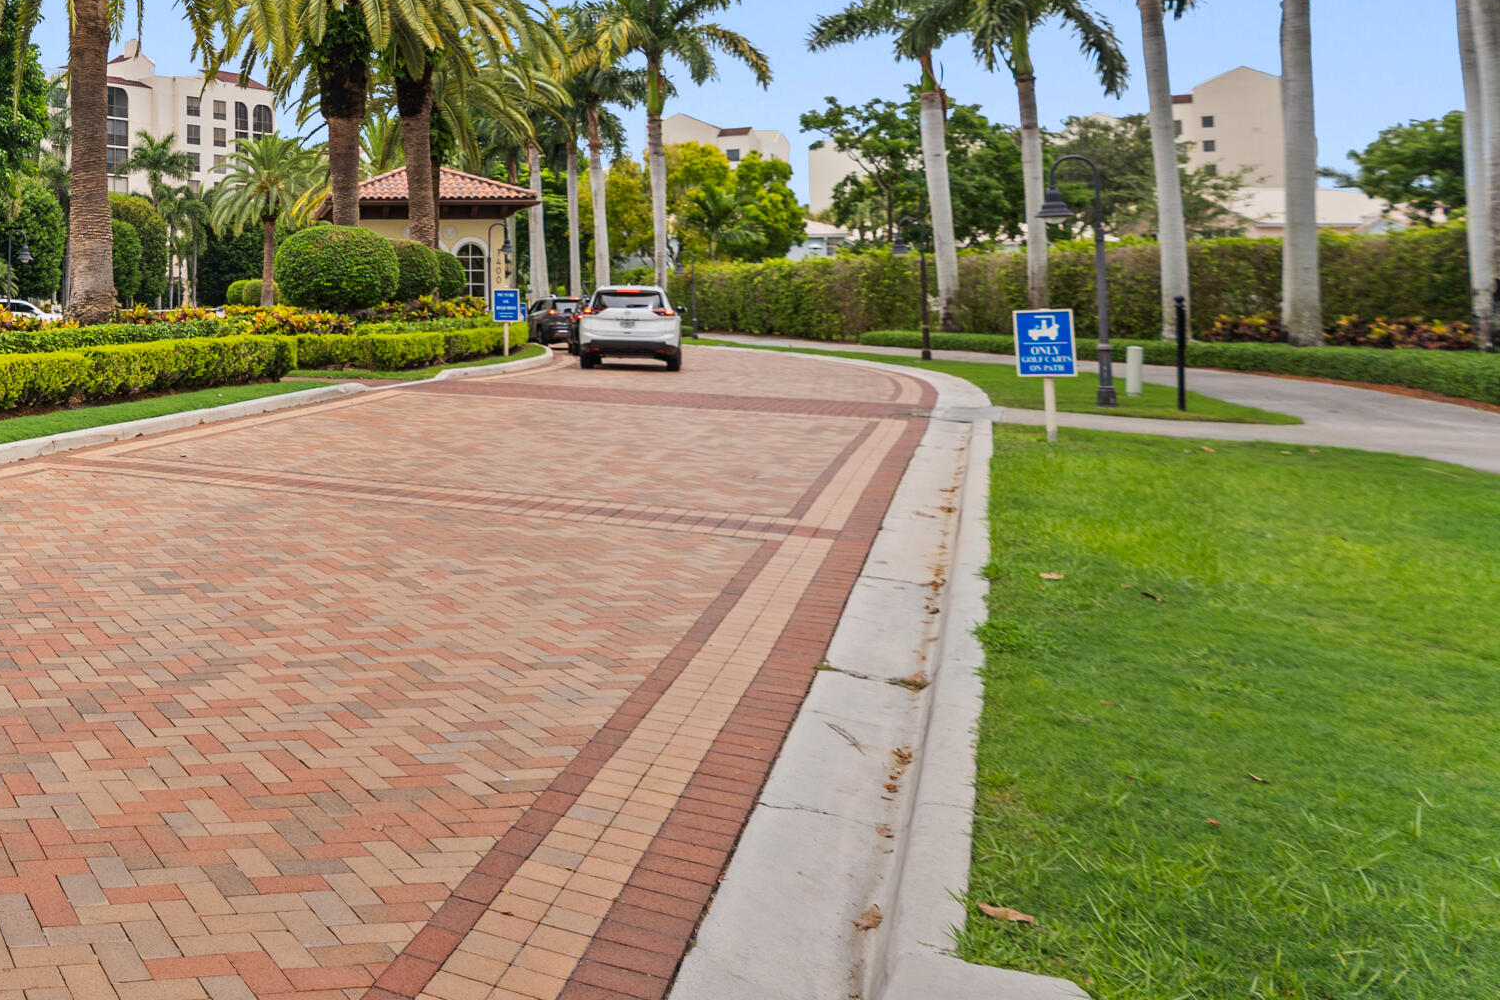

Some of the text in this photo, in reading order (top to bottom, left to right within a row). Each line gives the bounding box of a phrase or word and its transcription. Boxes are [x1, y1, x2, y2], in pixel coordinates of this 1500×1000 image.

[1030, 346, 1059, 355] ONLY
[1021, 355, 1073, 363] GOLF CARTS
[1029, 364, 1065, 372] ON PATH
